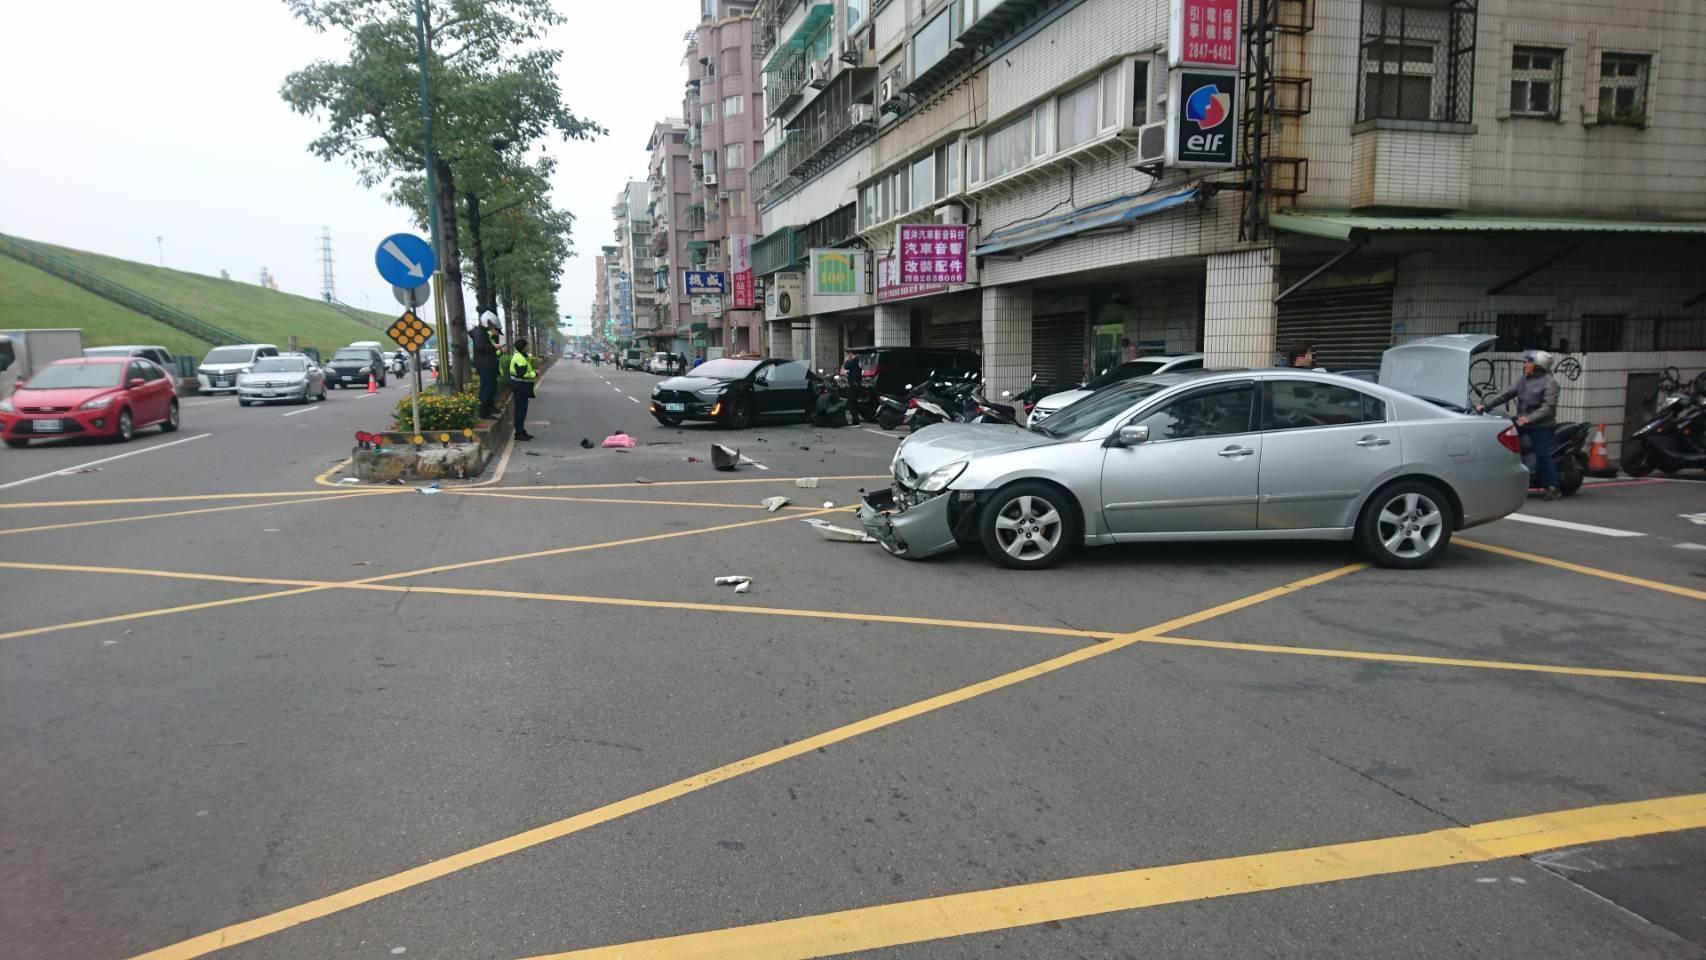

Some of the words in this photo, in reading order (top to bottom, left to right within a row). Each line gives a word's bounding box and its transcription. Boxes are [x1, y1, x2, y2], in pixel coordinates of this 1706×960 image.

[1190, 5, 1200, 38] 引擎
[1189, 42, 1231, 60] 2847-6481
[1187, 133, 1224, 151] elf
[905, 242, 963, 255] 汽車音響
[905, 260, 963, 273] 改裝配件
